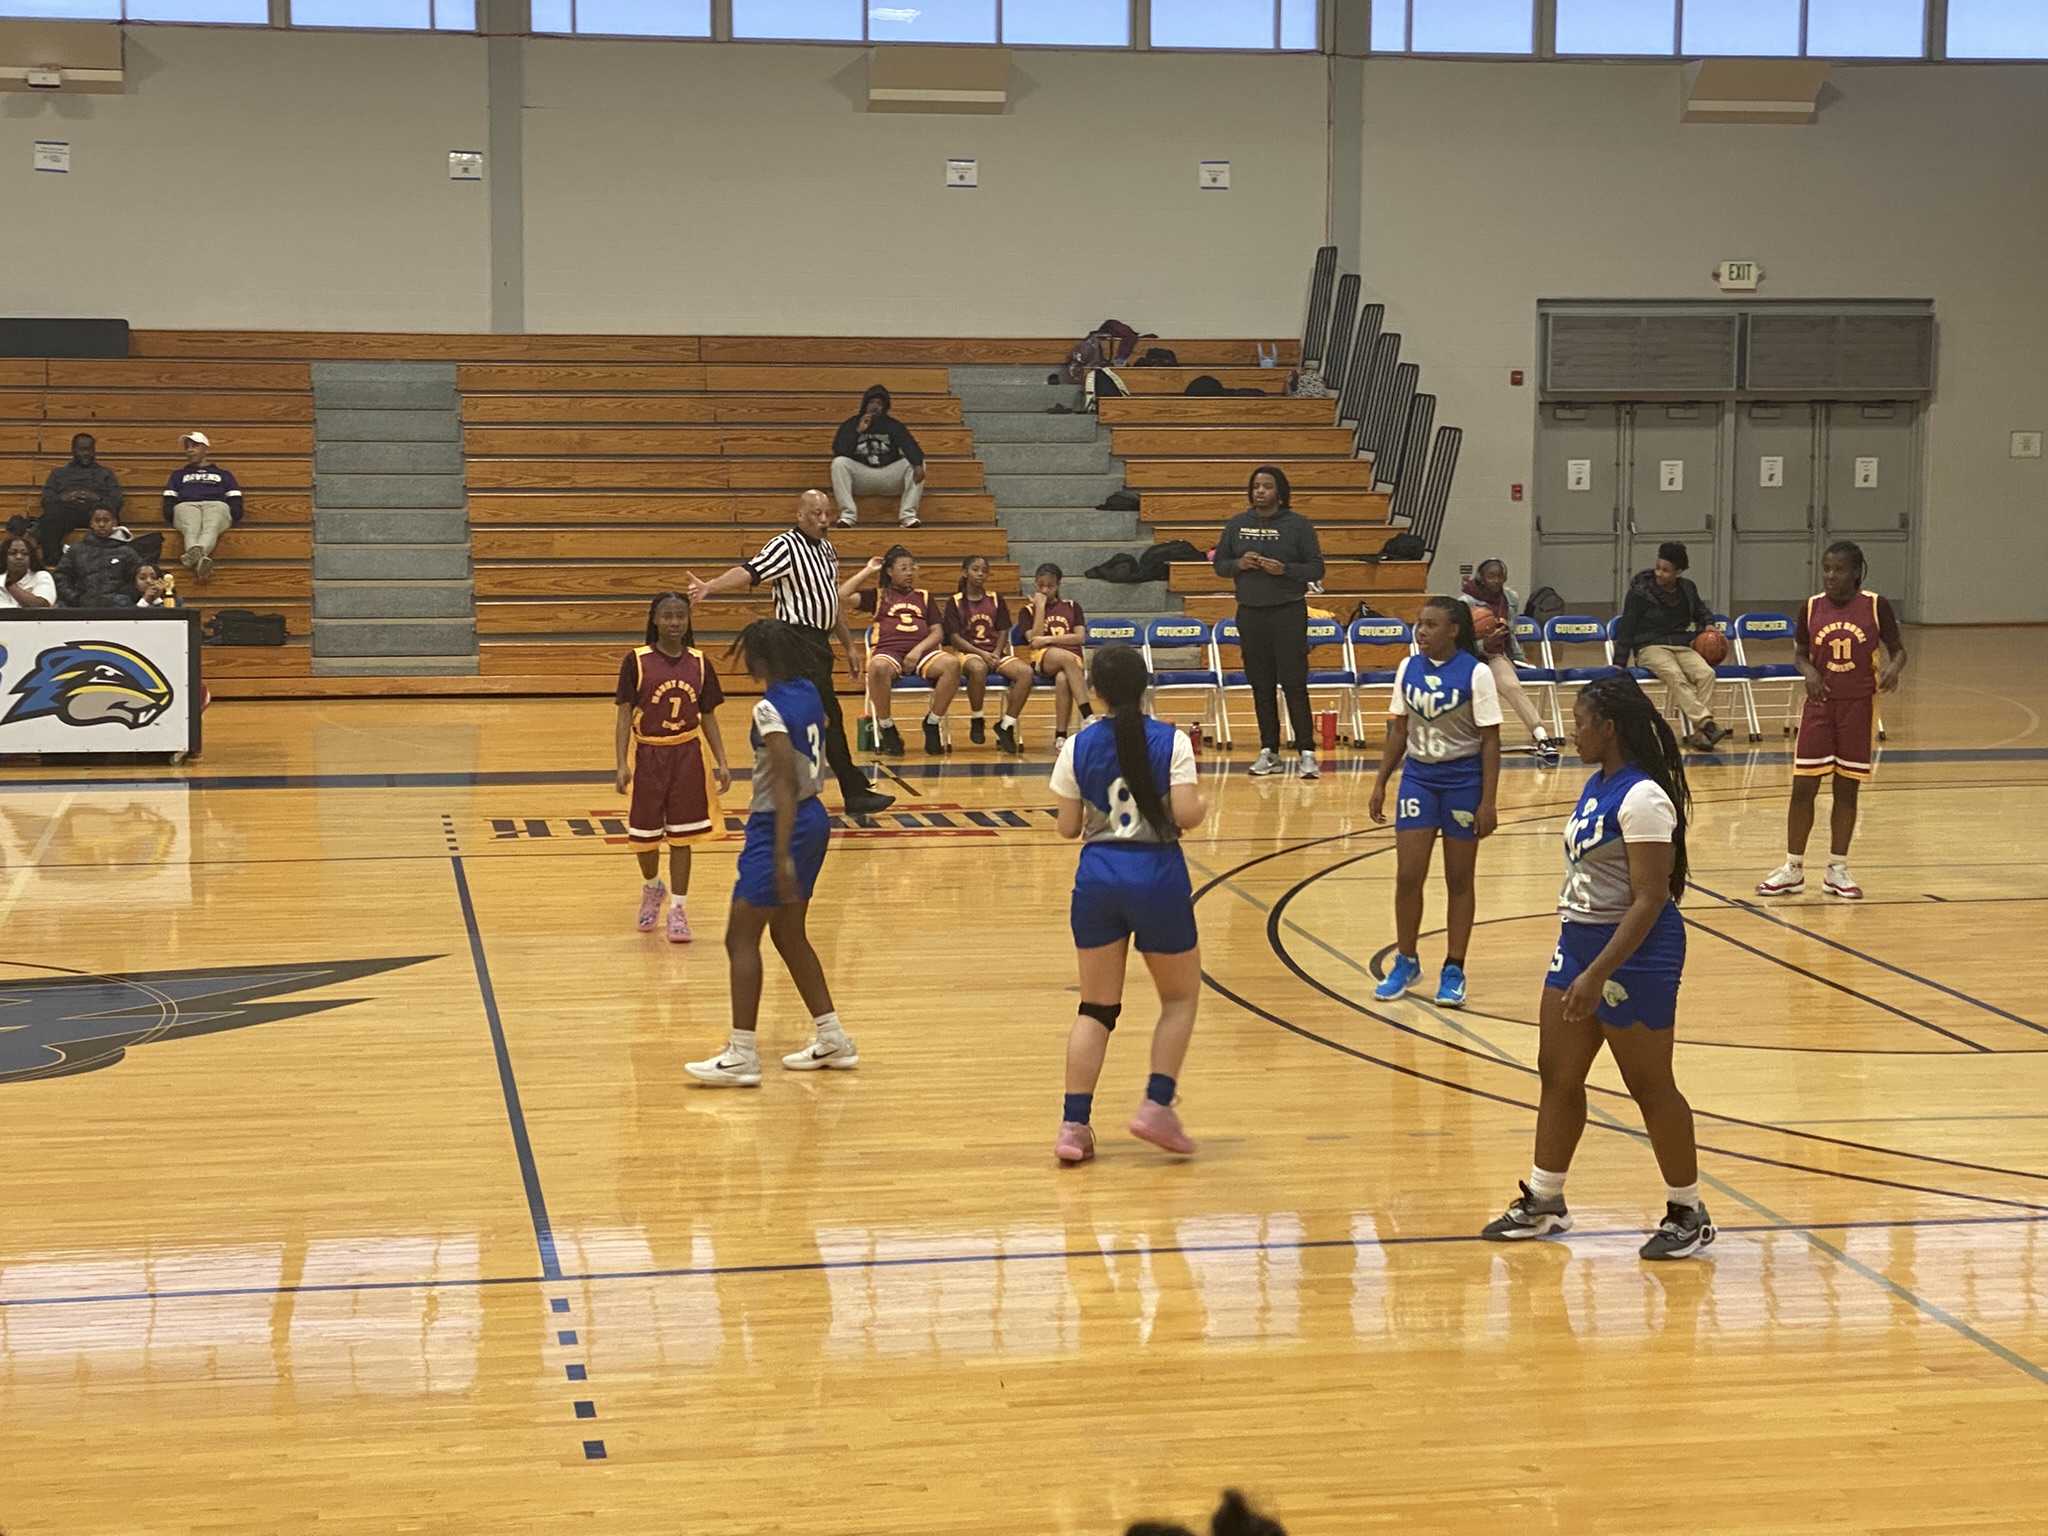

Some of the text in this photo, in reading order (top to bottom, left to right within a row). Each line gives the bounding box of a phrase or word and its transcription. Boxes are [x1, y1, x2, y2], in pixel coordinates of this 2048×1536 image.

[1729, 263, 1753, 281] EXIT
[899, 613, 913, 624] 5
[1746, 620, 1787, 631] GOUCHER
[975, 624, 986, 639] 2
[1828, 638, 1852, 660] 11
[806, 723, 821, 779] 3
[1416, 725, 1446, 757] 16
[1107, 776, 1142, 838] 8
[1400, 798, 1421, 819] 16
